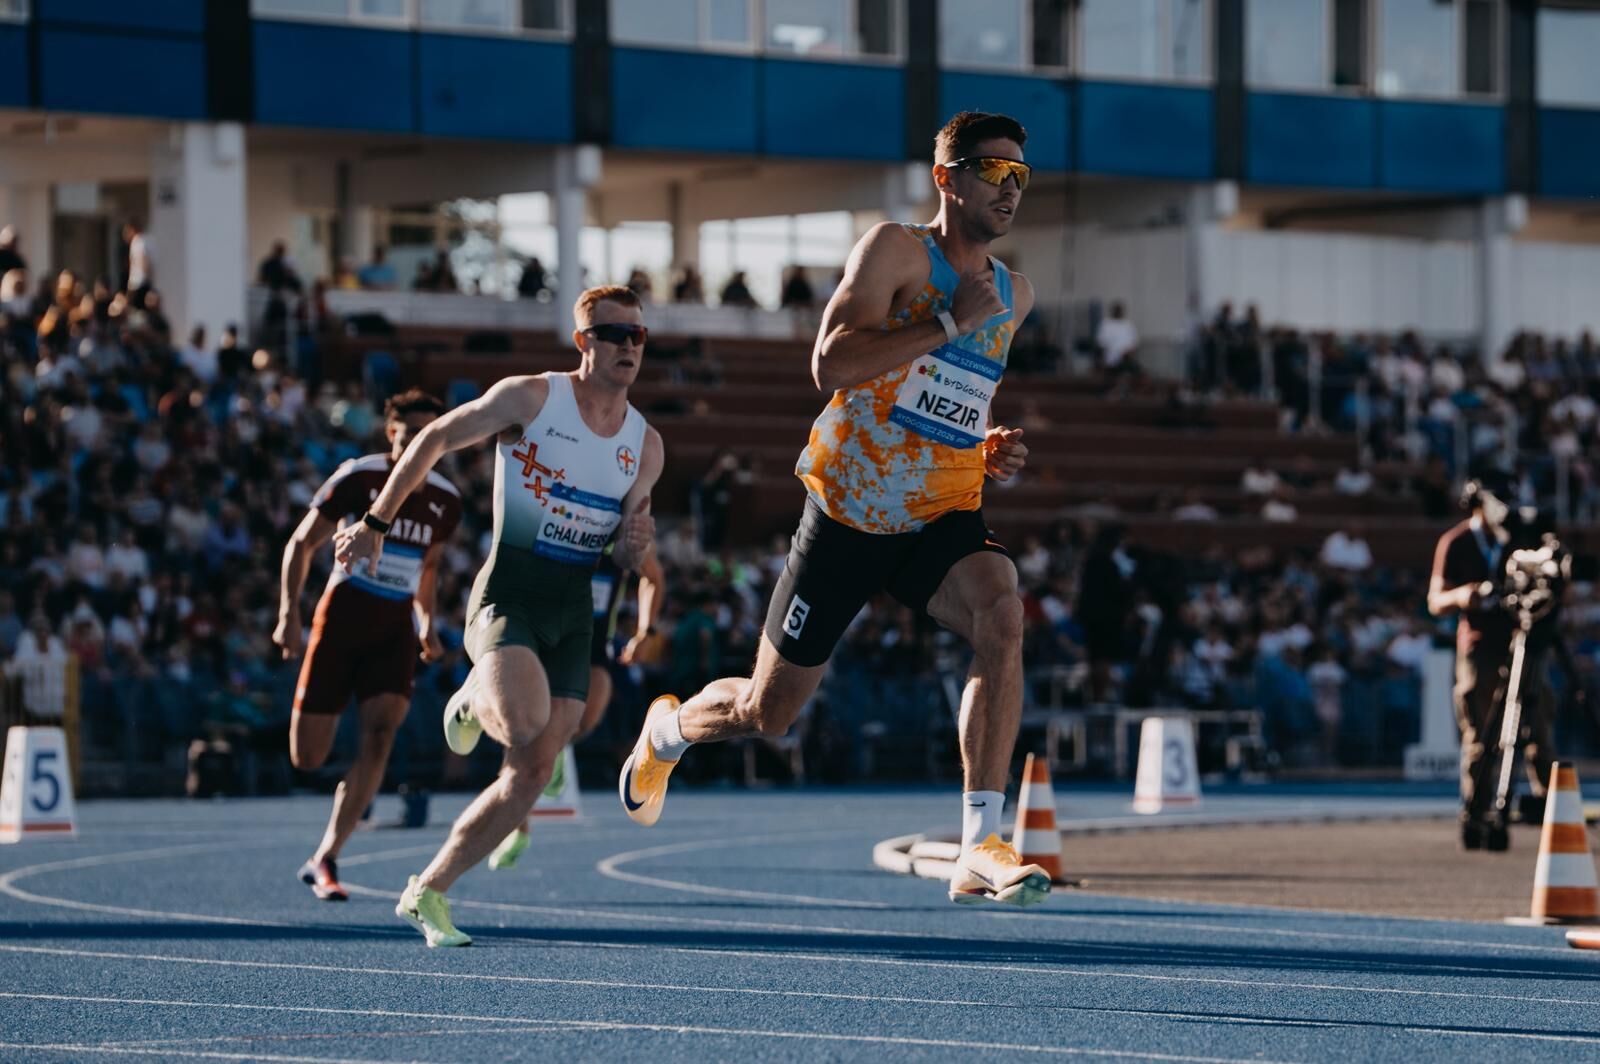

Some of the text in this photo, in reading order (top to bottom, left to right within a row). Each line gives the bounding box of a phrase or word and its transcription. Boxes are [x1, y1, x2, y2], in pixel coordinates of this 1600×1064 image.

[916, 389, 980, 430] NEZIR
[386, 518, 433, 545] ATAR
[789, 604, 806, 631] 5
[31, 750, 60, 812] 5
[1164, 738, 1188, 788] 3
